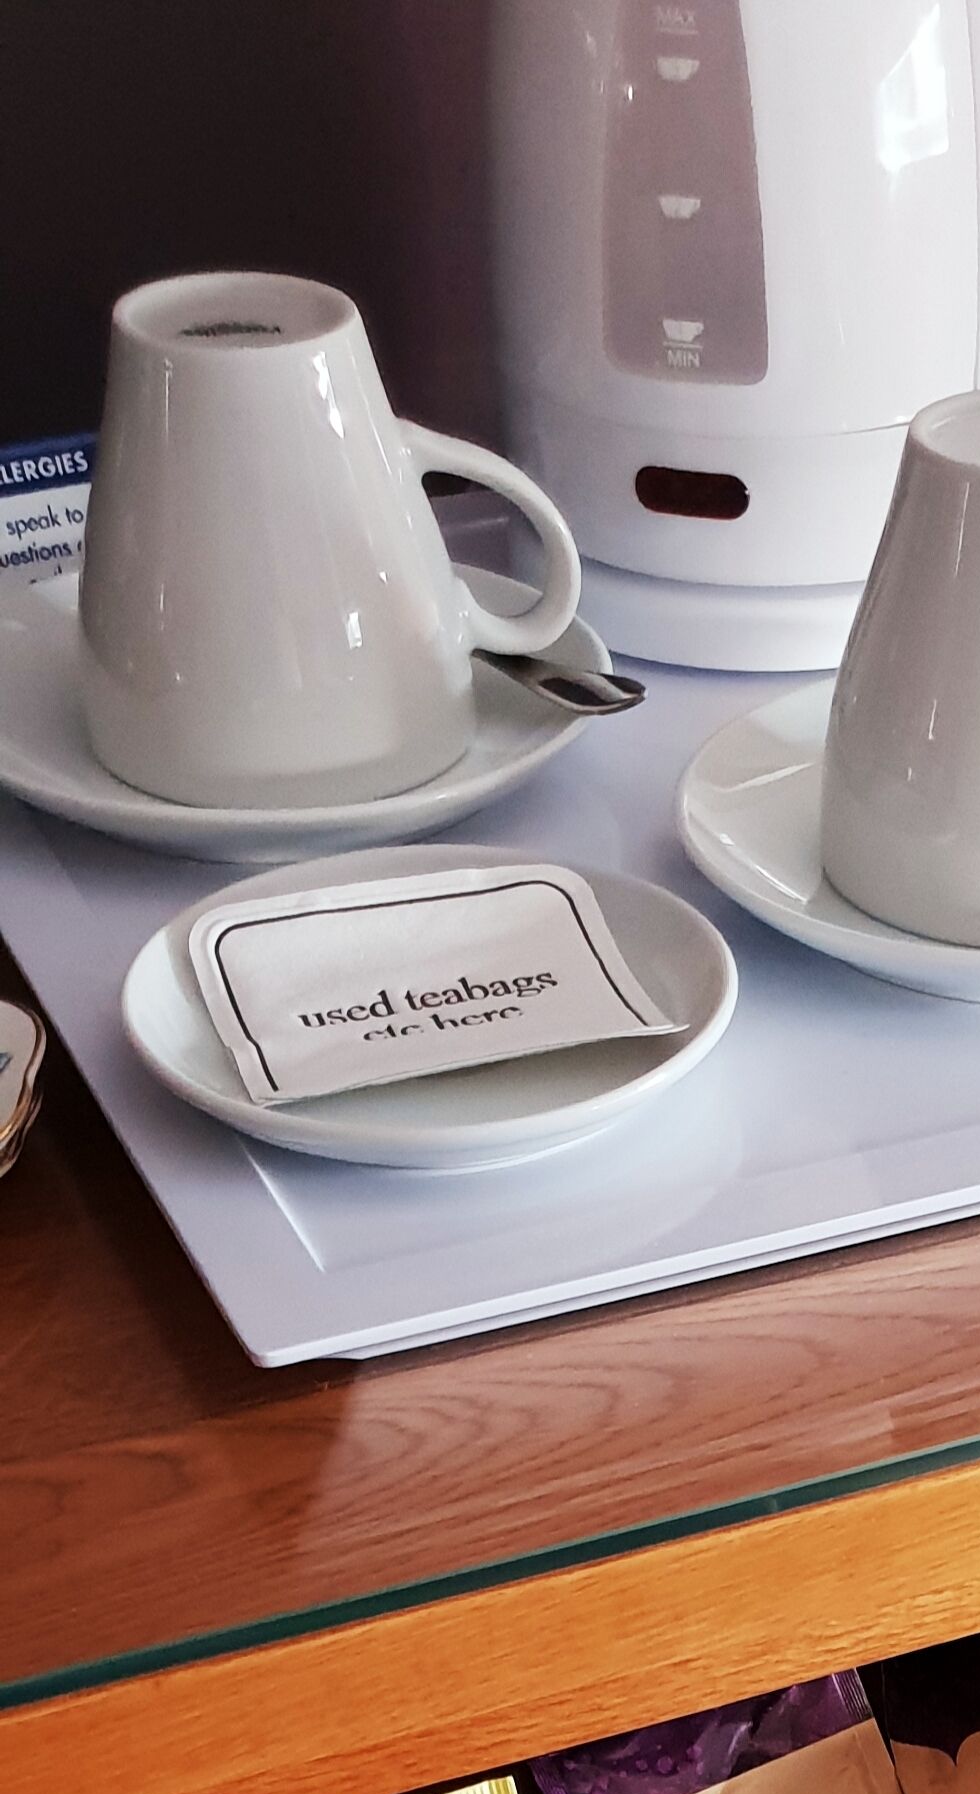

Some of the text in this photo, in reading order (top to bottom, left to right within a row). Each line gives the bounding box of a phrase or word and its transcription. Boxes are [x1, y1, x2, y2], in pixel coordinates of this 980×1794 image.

[667, 350, 700, 368] MIN
[0, 451, 89, 485] LERGIES
[6, 505, 84, 540] speak to
[298, 972, 558, 1028] used teabags
